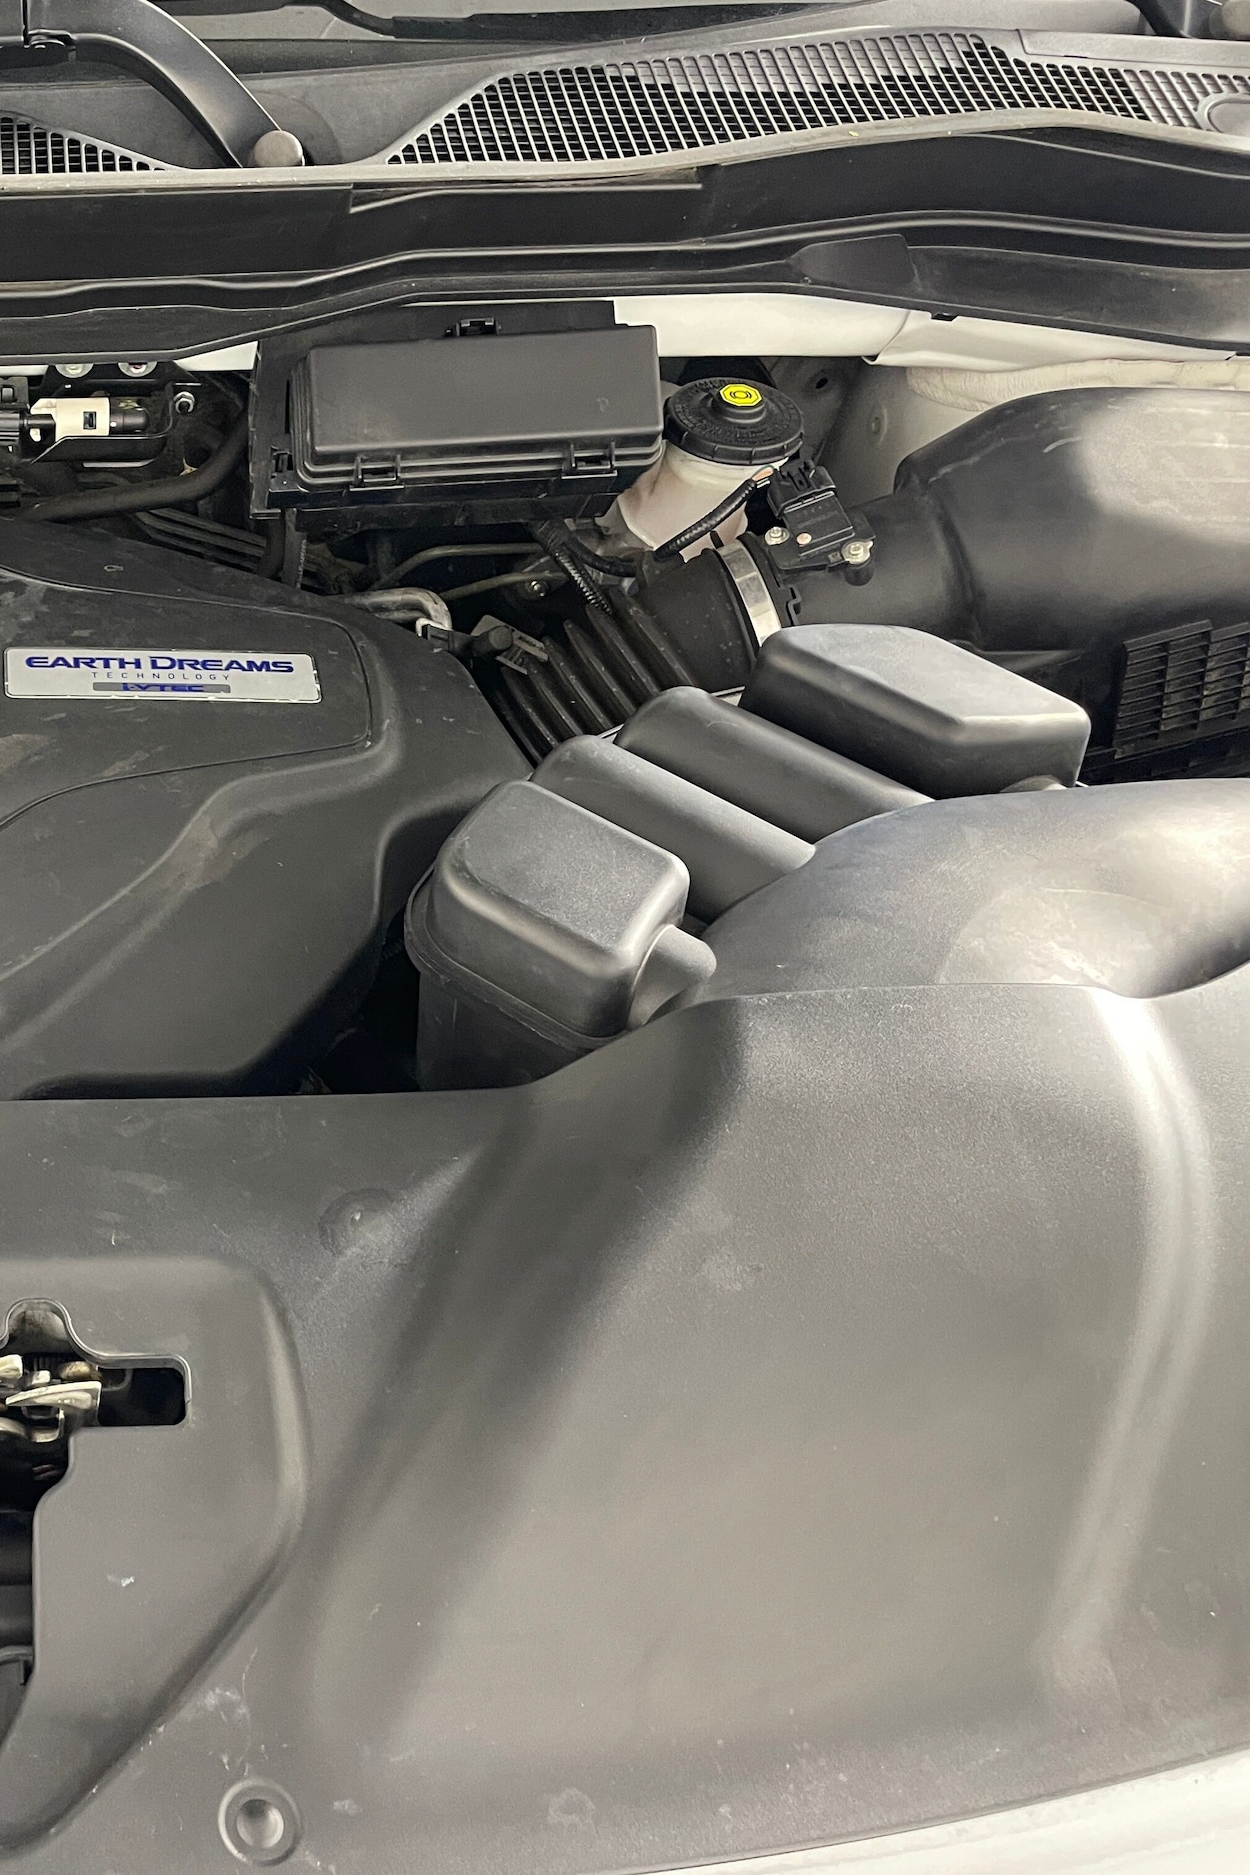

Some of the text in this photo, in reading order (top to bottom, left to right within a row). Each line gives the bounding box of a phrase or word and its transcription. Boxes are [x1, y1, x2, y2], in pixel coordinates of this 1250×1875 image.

[25, 656, 294, 673] EARTH DREAMS
[92, 671, 231, 681] TECHNOLOGY
